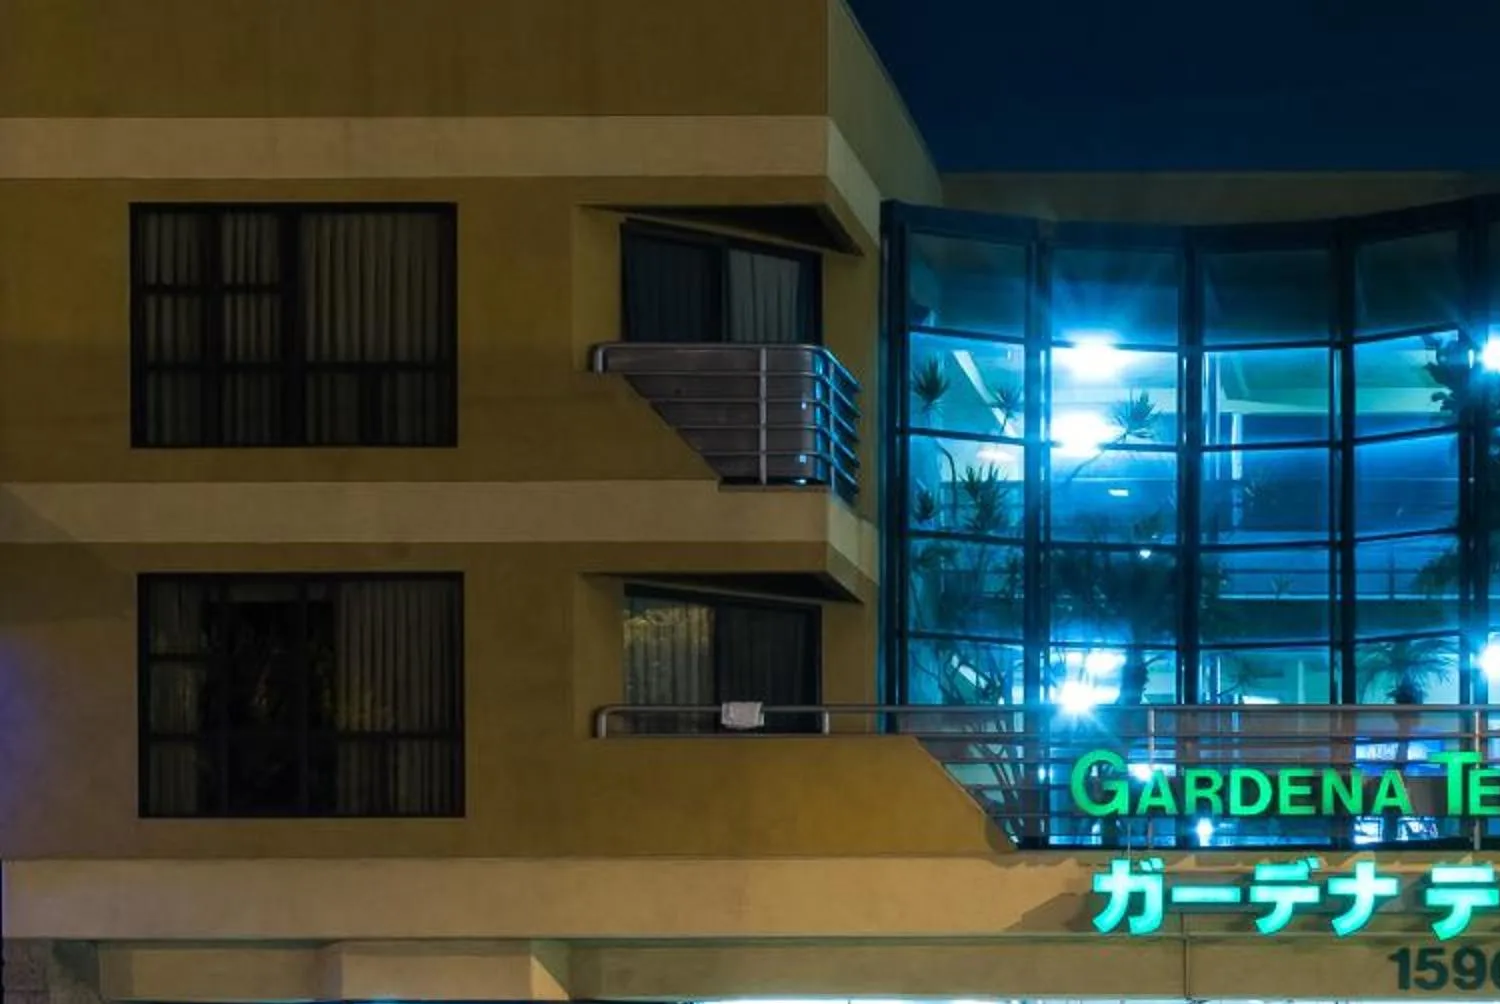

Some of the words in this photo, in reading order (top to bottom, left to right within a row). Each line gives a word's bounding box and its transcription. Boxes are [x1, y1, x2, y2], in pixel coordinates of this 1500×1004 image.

[1070, 749, 1414, 817] GARDENA
[1092, 857, 1399, 937] ガーデナ
